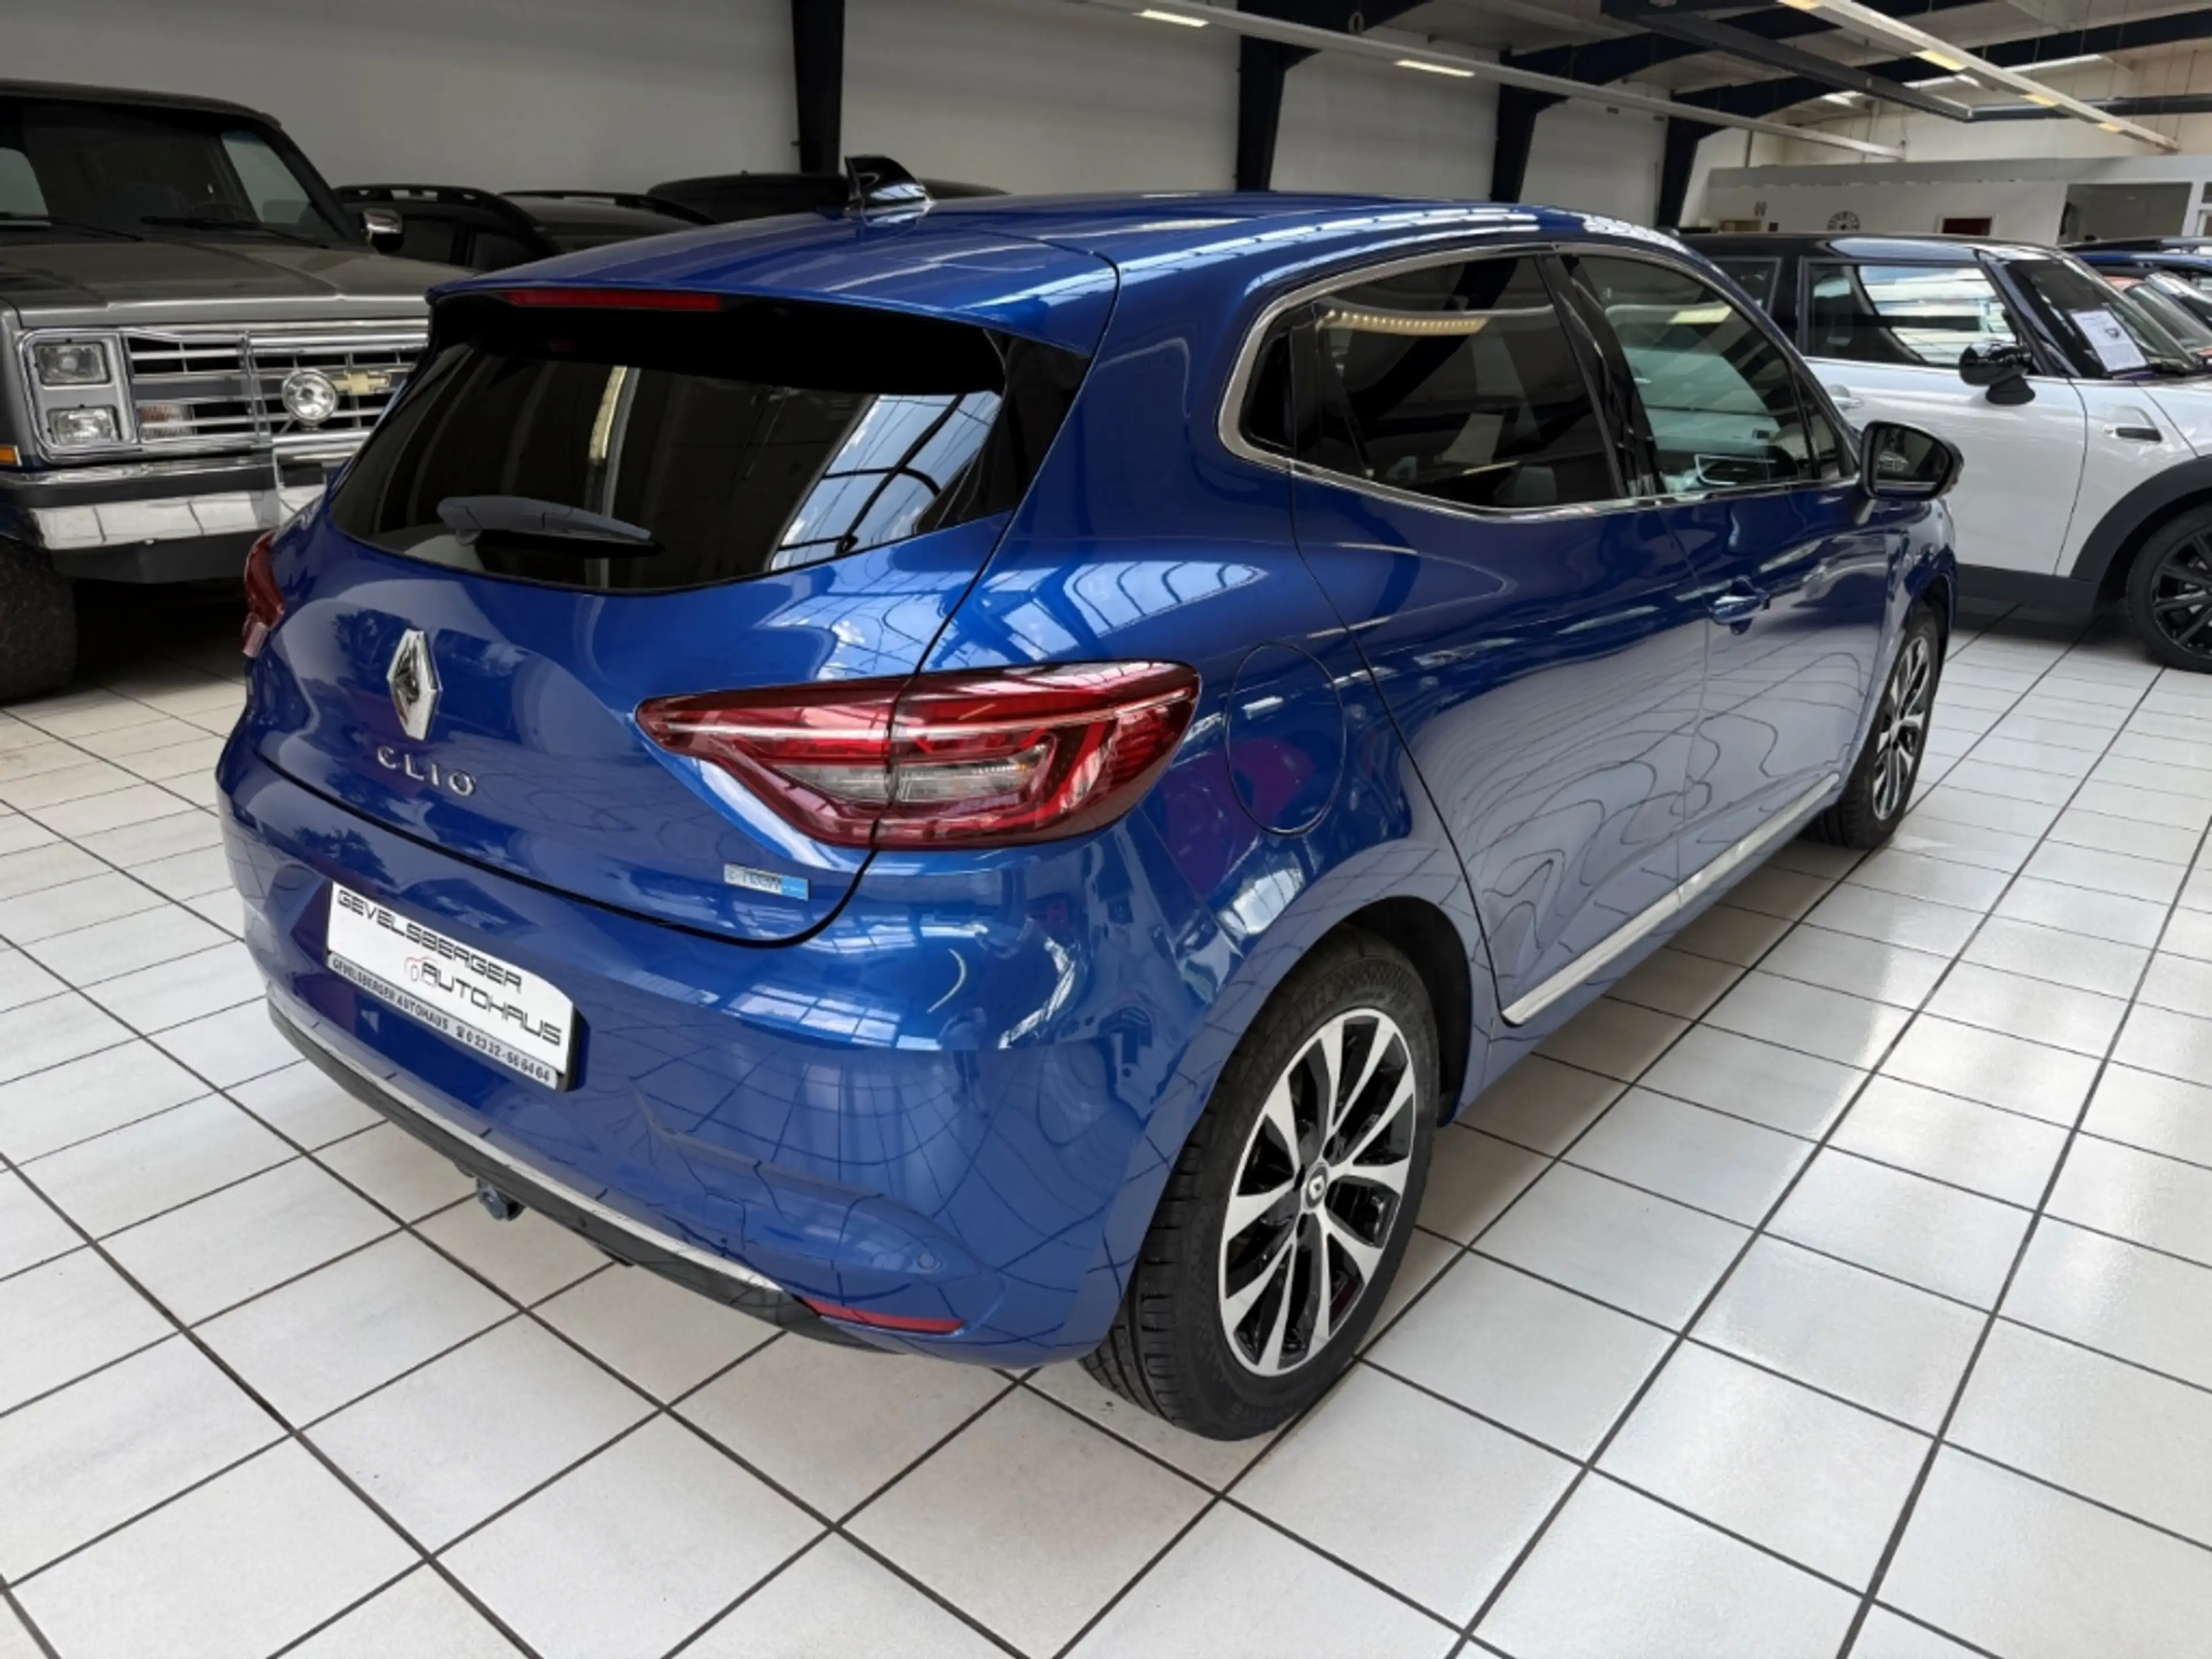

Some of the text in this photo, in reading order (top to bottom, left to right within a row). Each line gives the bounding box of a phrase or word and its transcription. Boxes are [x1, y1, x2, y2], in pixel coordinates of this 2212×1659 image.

[377, 745, 476, 796] CLIO
[337, 888, 522, 994] GEVELSBERGER
[421, 960, 562, 1047] AUTOHAUS
